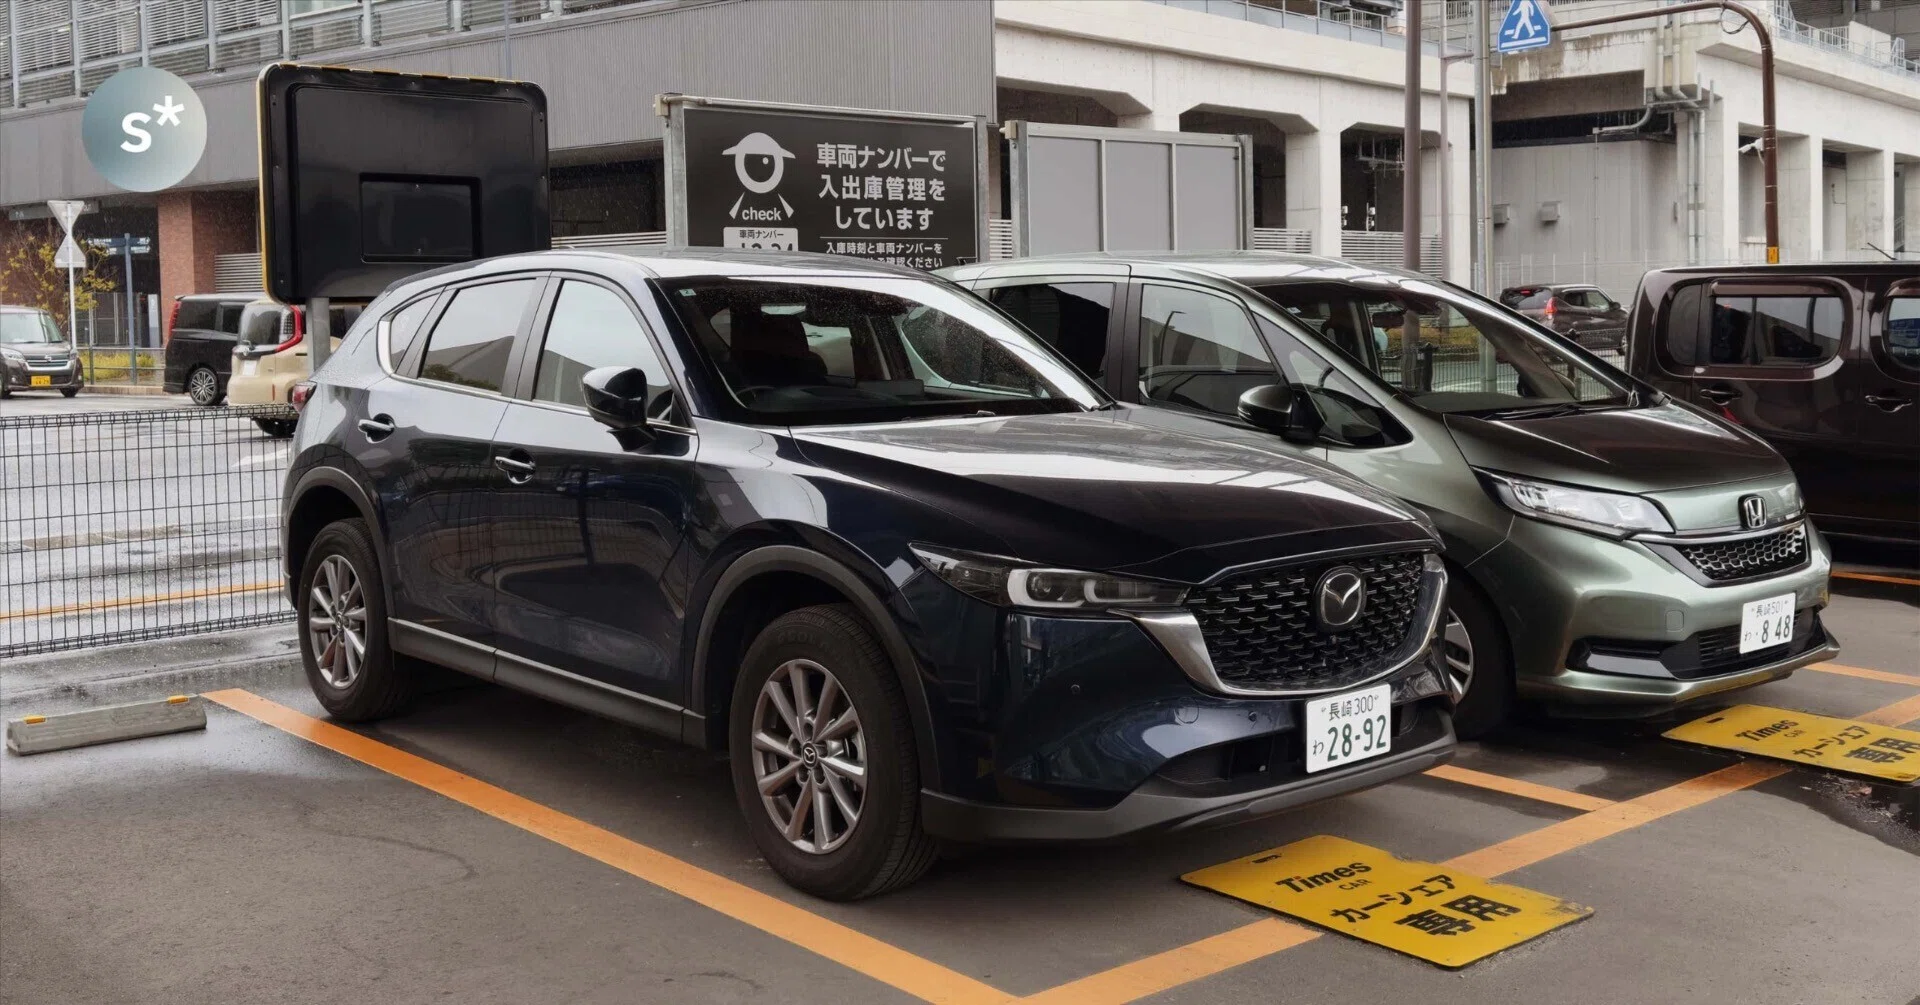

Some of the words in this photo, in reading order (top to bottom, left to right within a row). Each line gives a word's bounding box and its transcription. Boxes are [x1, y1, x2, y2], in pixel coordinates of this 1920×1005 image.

[816, 142, 946, 172] 車両ナンバーで
[818, 174, 946, 202] 入出庫管理を
[741, 206, 782, 221] check
[835, 205, 934, 231] しています
[739, 229, 784, 239] 車両ナンバー
[826, 241, 942, 255] 入庫時刻と車両ナンバーを
[1735, 719, 1799, 741] Times
[1275, 862, 1372, 893] Times
[1339, 878, 1372, 890] CAR
[1330, 874, 1456, 923] カーシェア
[1393, 894, 1522, 936] 専用
